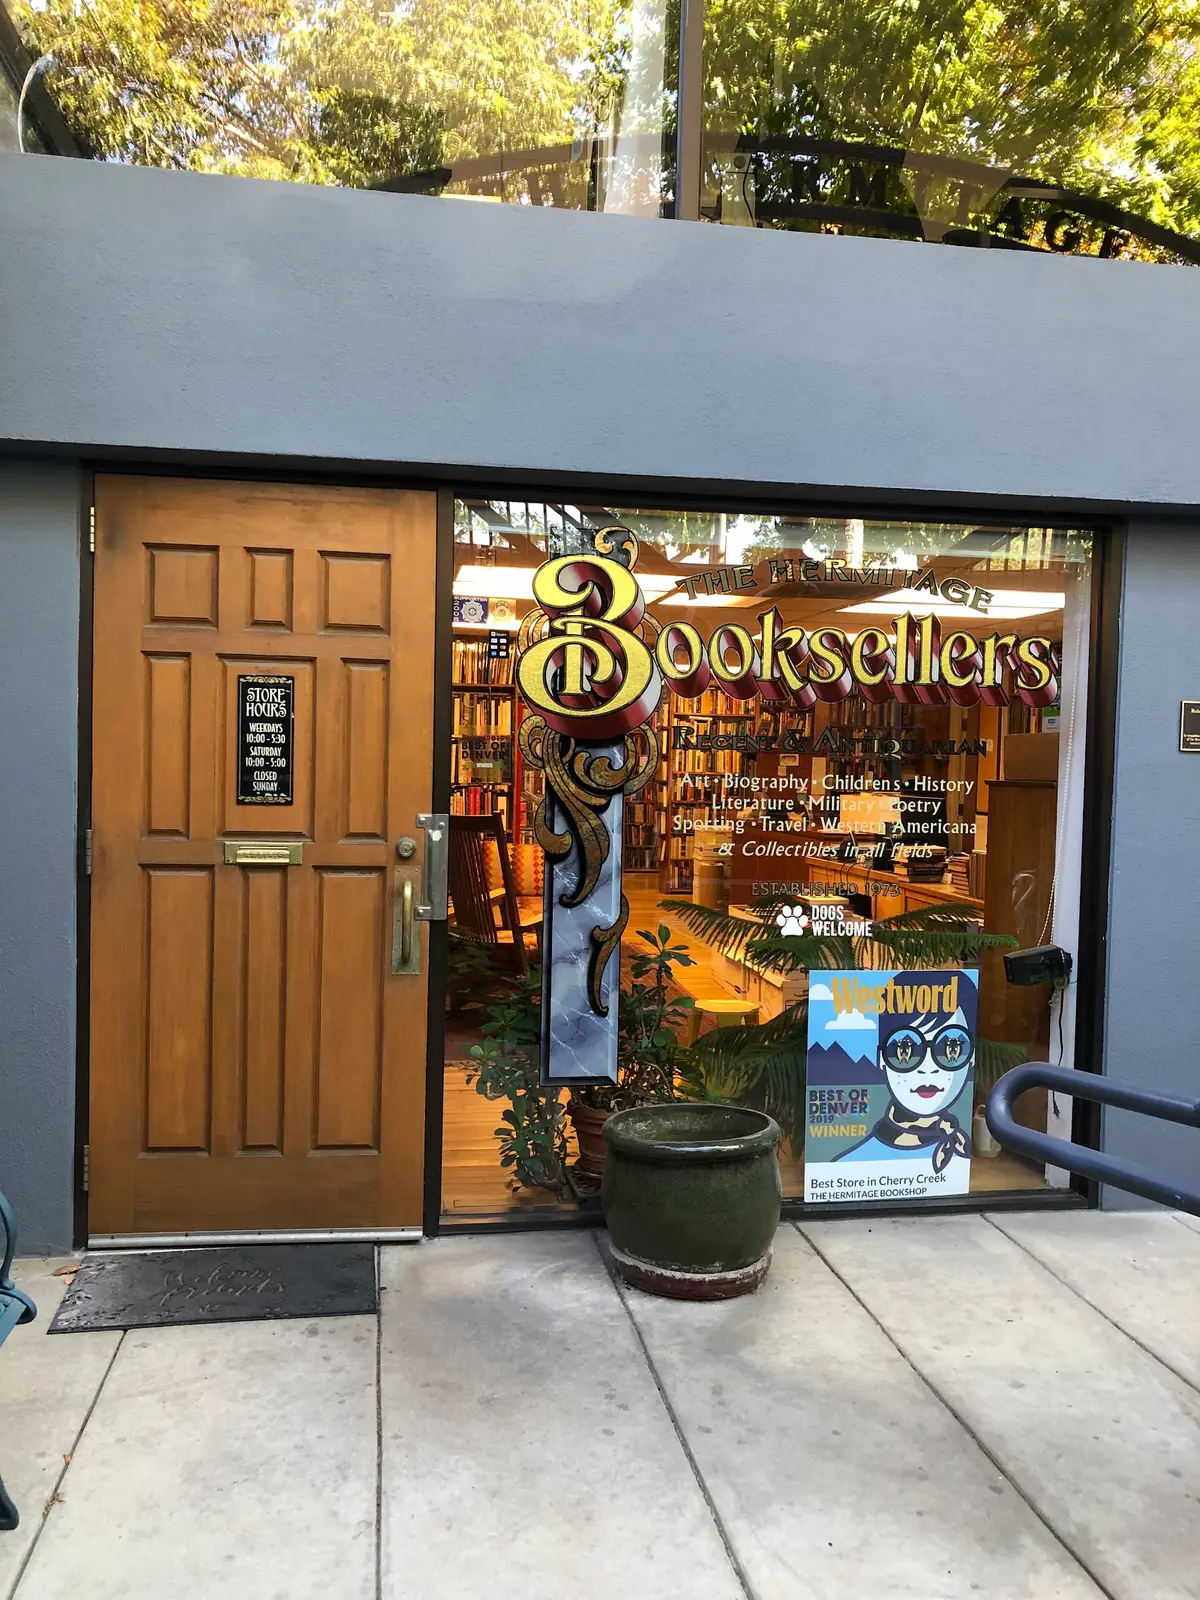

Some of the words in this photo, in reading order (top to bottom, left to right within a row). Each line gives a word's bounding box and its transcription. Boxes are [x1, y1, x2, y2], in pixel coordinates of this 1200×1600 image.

[675, 564, 758, 600] THE
[768, 556, 995, 615] HERMITAGE
[515, 553, 1060, 740] Booksellers
[247, 687, 291, 703] STORE
[246, 702, 287, 718] HOURS
[249, 722, 283, 733] WEEKDAYS
[246, 734, 265, 744] 10:00
[271, 734, 286, 744] 5:30
[461, 742, 487, 750] BEST
[782, 728, 806, 752] &
[250, 746, 282, 757] SATURDAY
[245, 757, 265, 767] 10:00
[271, 758, 286, 768] 5:00
[253, 771, 277, 781] CLOSED
[252, 781, 278, 791] SUNDAY
[680, 773, 711, 788] Art
[724, 773, 809, 793] Biography
[914, 776, 974, 795] History
[712, 794, 794, 810] Literature
[808, 795, 876, 813] Military
[889, 797, 941, 815] Poetry
[673, 815, 746, 834] Sporting
[759, 816, 807, 832] Travel
[820, 817, 886, 834] Western
[891, 819, 977, 834] Americana
[717, 843, 735, 856] &
[742, 841, 837, 857] Collectibles
[844, 843, 859, 857] in
[865, 843, 886, 858] all
[890, 842, 933, 858] fields
[751, 881, 859, 896] ESTABLISHED
[864, 882, 900, 897] 1973
[811, 905, 844, 920] DOGS
[812, 921, 873, 936] WELCOME
[831, 976, 959, 1015] Westword
[809, 1090, 843, 1102] BEST
[848, 1089, 868, 1101] OF
[809, 1102, 868, 1115] DENVER
[809, 1114, 834, 1124] 2019
[809, 1124, 867, 1138] WINNER
[811, 1178, 833, 1189] Best
[836, 1176, 865, 1188] Store
[867, 1176, 877, 1186] in
[879, 1172, 914, 1189] Cherry
[917, 1173, 946, 1183] Creek
[810, 1192, 827, 1201] THE
[828, 1189, 879, 1200] HERMITAGE
[880, 1187, 927, 1198] BOOKSHOP
